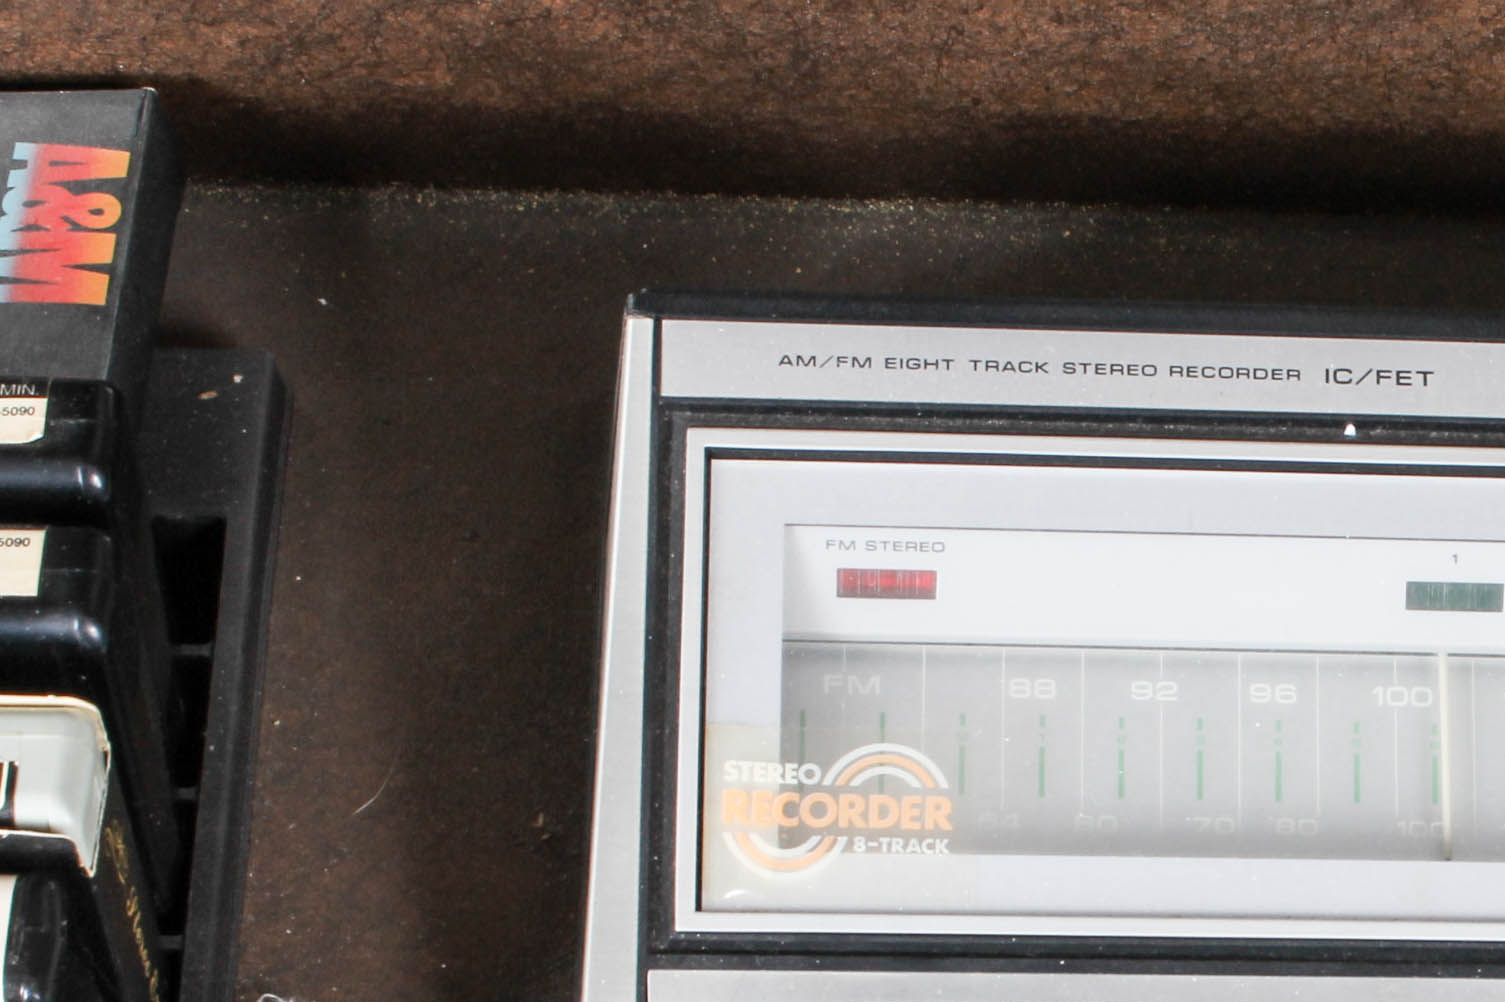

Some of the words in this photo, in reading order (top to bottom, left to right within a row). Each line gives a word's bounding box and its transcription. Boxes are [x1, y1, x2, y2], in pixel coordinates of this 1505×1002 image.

[0, 142, 131, 306] A&M
[778, 354, 872, 369] AM/FM
[884, 357, 955, 371] EIGHT
[968, 359, 1049, 374] TRACK
[1062, 361, 1158, 377] STEREO
[1169, 365, 1301, 382] RECORDER
[1325, 367, 1435, 387] IC/FET
[0, 383, 40, 396] MIN.
[825, 539, 857, 551] FM
[864, 539, 946, 553] STEREO
[1451, 553, 1459, 565] 1
[822, 675, 882, 697] FM
[1008, 678, 1057, 700] 88
[1130, 680, 1179, 702] 92
[1249, 683, 1297, 705] 96
[1371, 685, 1433, 708] 100
[723, 760, 822, 785] STEREO
[721, 789, 953, 831] RECORDER
[1191, 816, 1236, 836] 70
[852, 836, 951, 855] 8-TRACK
